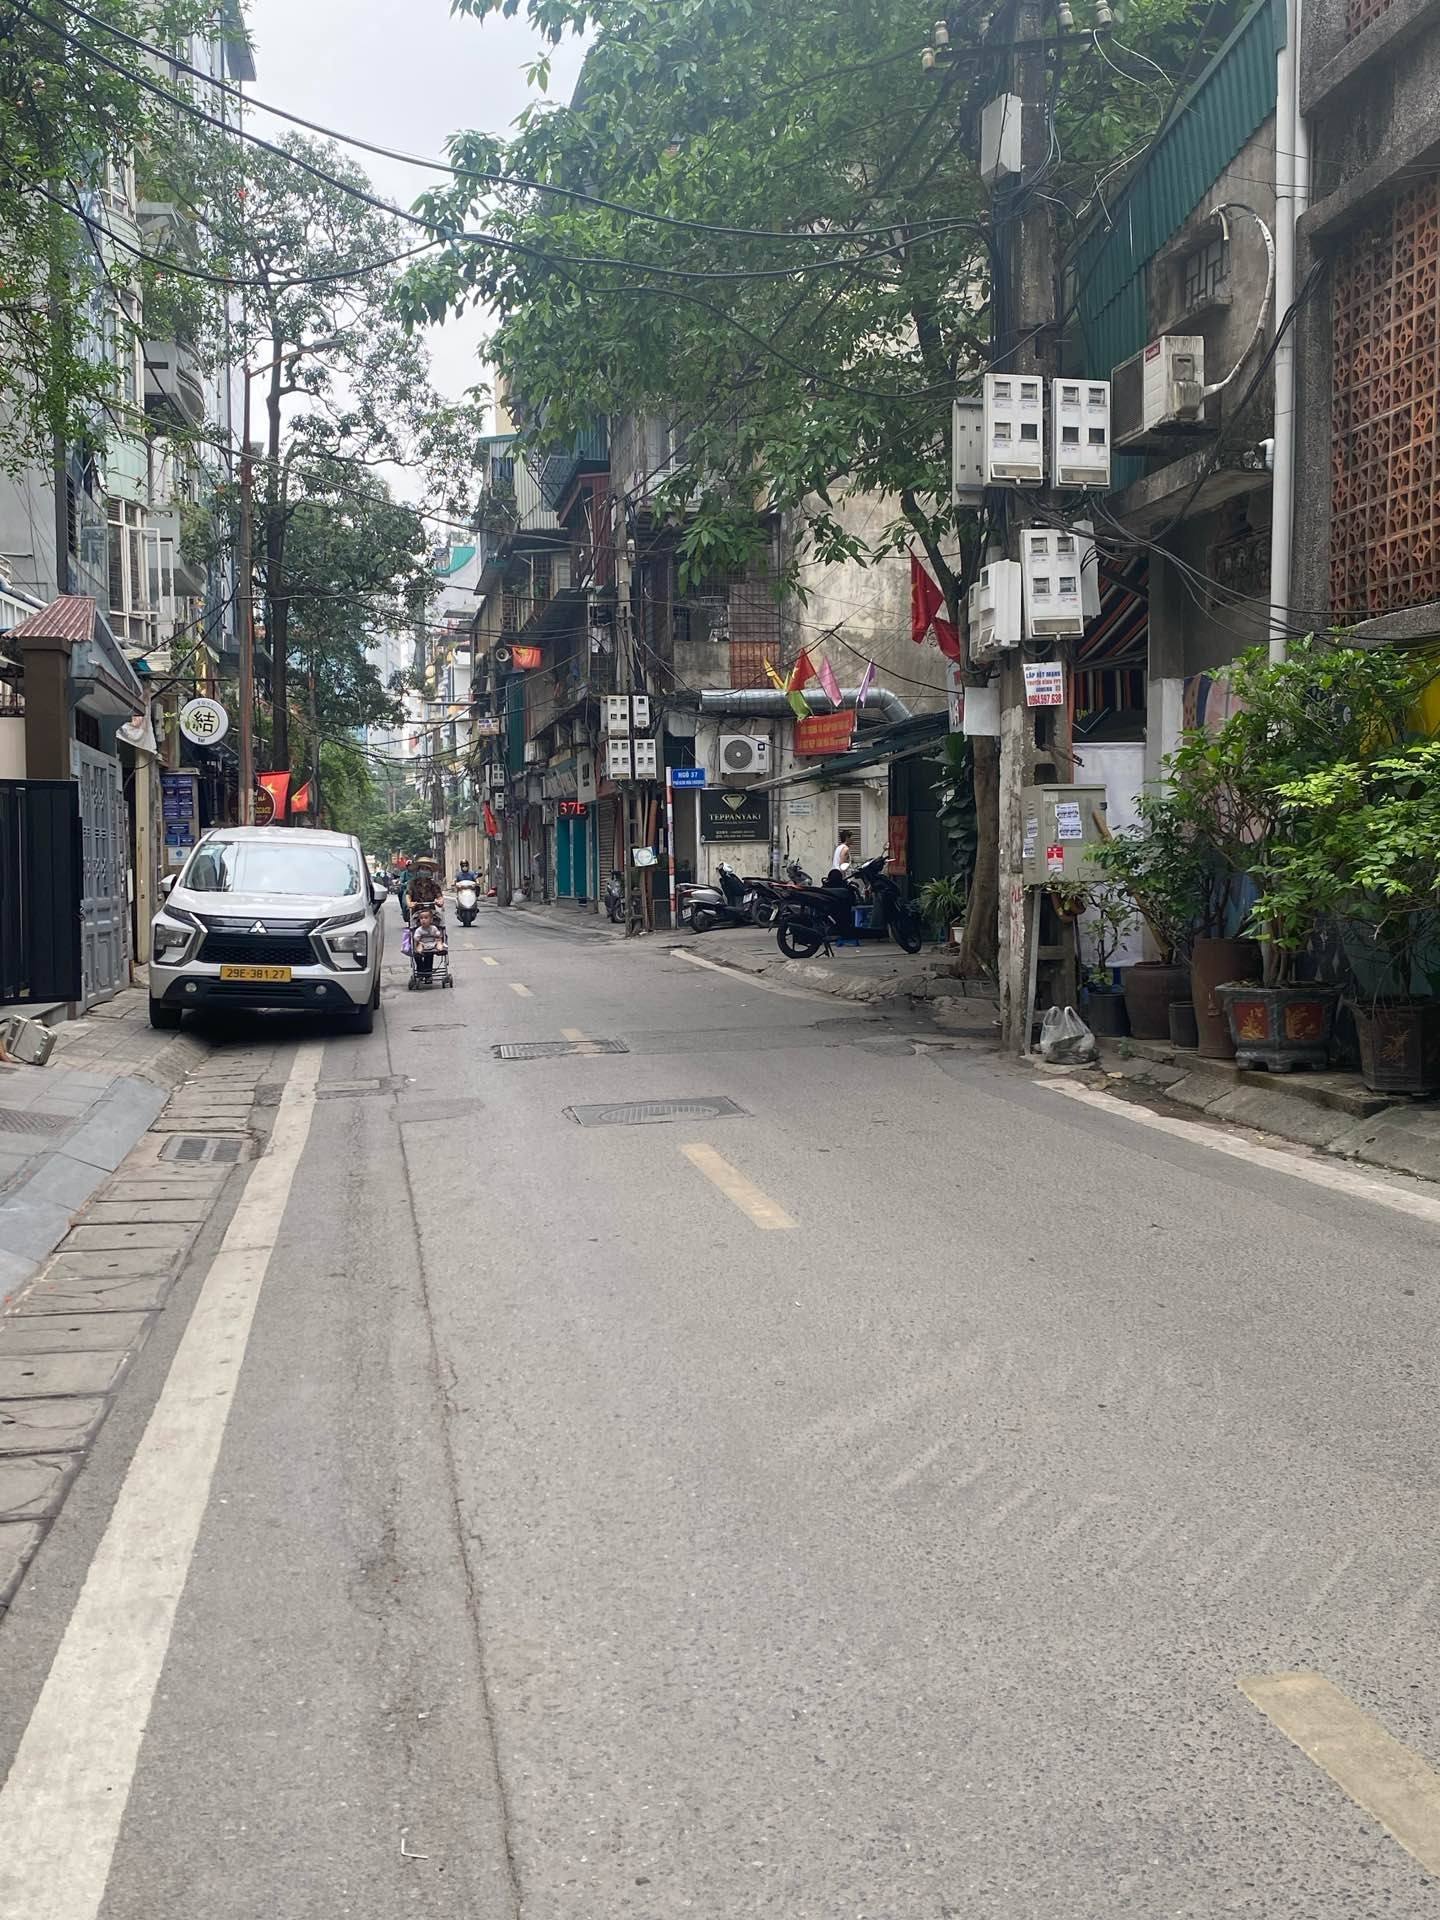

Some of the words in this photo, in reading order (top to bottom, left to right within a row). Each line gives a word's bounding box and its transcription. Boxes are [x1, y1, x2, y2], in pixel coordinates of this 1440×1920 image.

[192, 710, 215, 733] 結
[690, 771, 698, 779] 37
[709, 813, 761, 821] TEPPANYAKI
[226, 967, 285, 979] 29E-381.27
